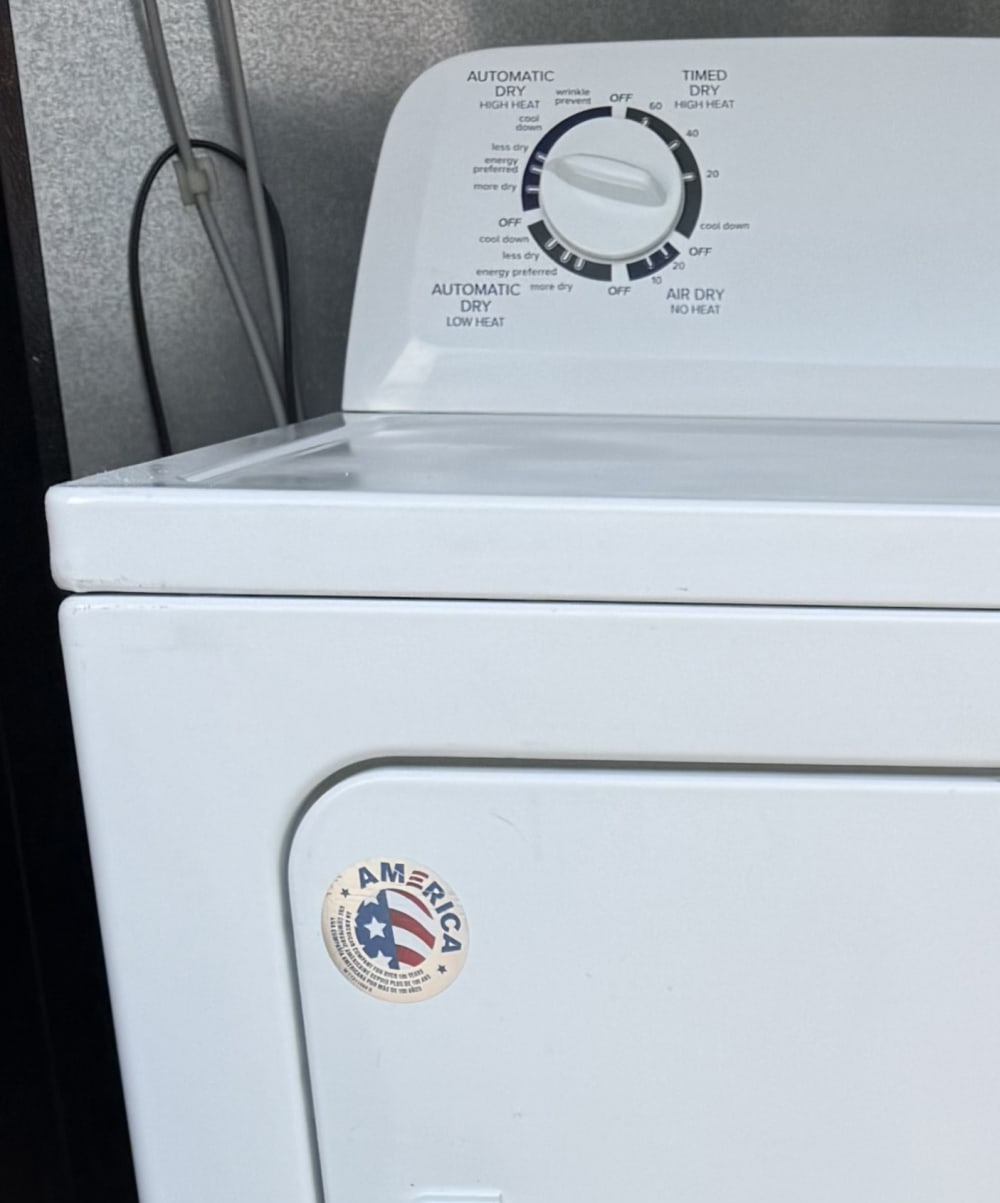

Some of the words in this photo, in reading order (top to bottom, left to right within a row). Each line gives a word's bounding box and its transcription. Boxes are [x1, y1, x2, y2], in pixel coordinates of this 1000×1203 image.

[467, 70, 555, 82] AUTOMATIC
[682, 70, 728, 81] TIMED
[495, 85, 526, 97] DRY
[555, 88, 590, 96] wrinkle
[690, 85, 720, 96] DRY
[555, 97, 591, 107] prevent
[609, 94, 633, 103] OFF
[480, 100, 508, 110] HIGH
[511, 100, 540, 109] HEAT
[649, 102, 662, 110] 60
[674, 100, 703, 109] HIGH
[706, 100, 735, 109] HEAT
[519, 115, 539, 123] cool
[516, 123, 542, 132] down
[686, 129, 699, 137] 40
[491, 143, 512, 151] less
[515, 143, 529, 153] dry
[485, 157, 519, 166] energy
[473, 165, 519, 174] preferred
[706, 170, 719, 179] 20
[473, 183, 498, 191] more
[501, 182, 517, 193] dry
[499, 218, 522, 227] OFF
[700, 222, 721, 230] cool
[723, 222, 750, 230] down
[479, 235, 500, 244] cool
[503, 235, 529, 244] down
[502, 252, 523, 260] less
[525, 252, 540, 262] dry
[689, 247, 712, 257] OFF
[672, 261, 685, 270] 20
[476, 268, 510, 277] energy
[512, 267, 557, 277] preferred
[652, 276, 662, 285] 10
[432, 283, 520, 296] AUTOMATIC
[530, 283, 555, 291] more
[557, 282, 573, 292] dry
[608, 286, 631, 296] OFF
[666, 289, 690, 300] AIR
[694, 289, 725, 301] DRY
[460, 300, 492, 313] DRY
[670, 305, 688, 314] NO
[690, 304, 720, 315] HEAT
[446, 317, 472, 327] LOW
[475, 317, 504, 327] HEAT
[358, 862, 462, 953] AMERICA
[346, 919, 356, 947] AMERICAN
[353, 947, 373, 968] COMPANY
[373, 966, 383, 974] FOR
[342, 957, 366, 981] AMERICANA
[367, 979, 377, 987] POR
